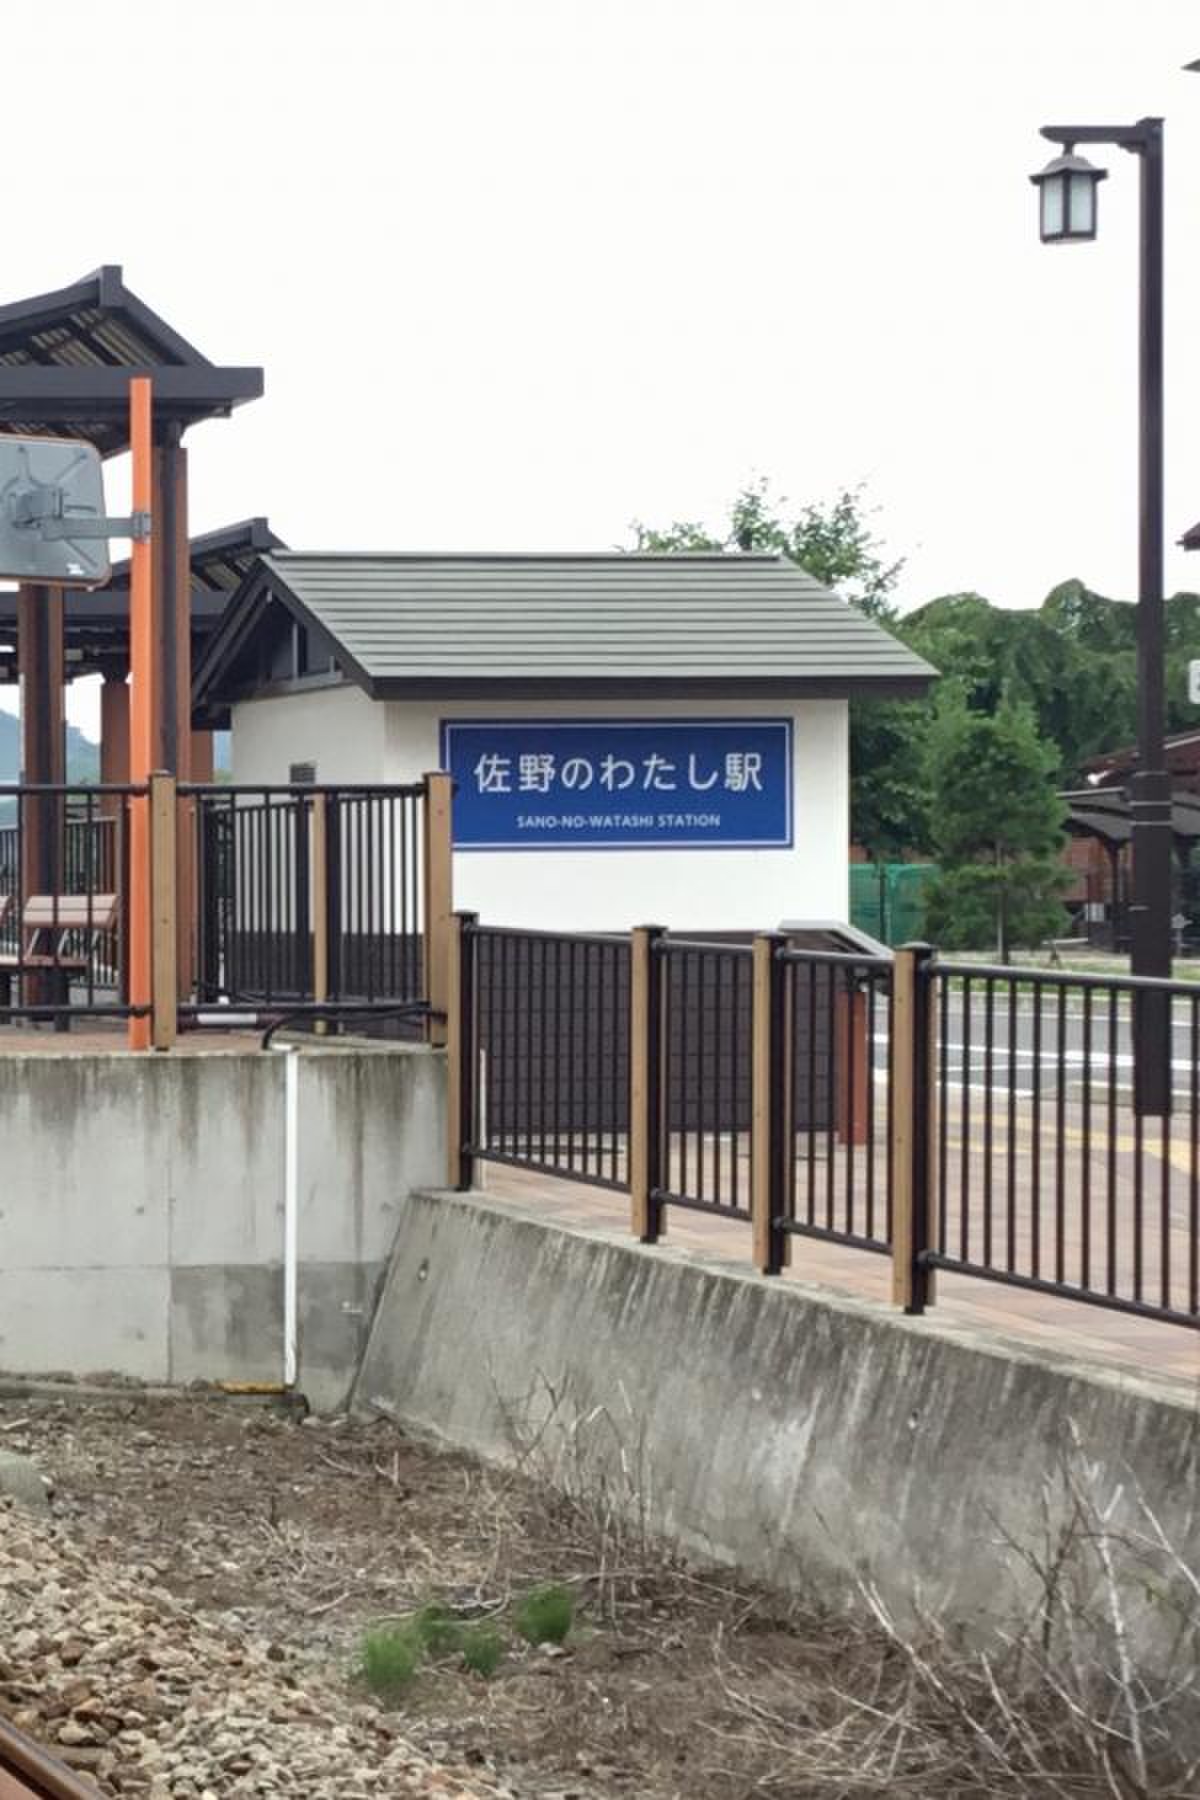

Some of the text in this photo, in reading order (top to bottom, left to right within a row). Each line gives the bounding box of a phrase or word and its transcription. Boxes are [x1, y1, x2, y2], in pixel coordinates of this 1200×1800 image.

[474, 752, 763, 794] 佐野のわたし駅
[516, 813, 721, 829] SANO-NO-WATASHI STATION
